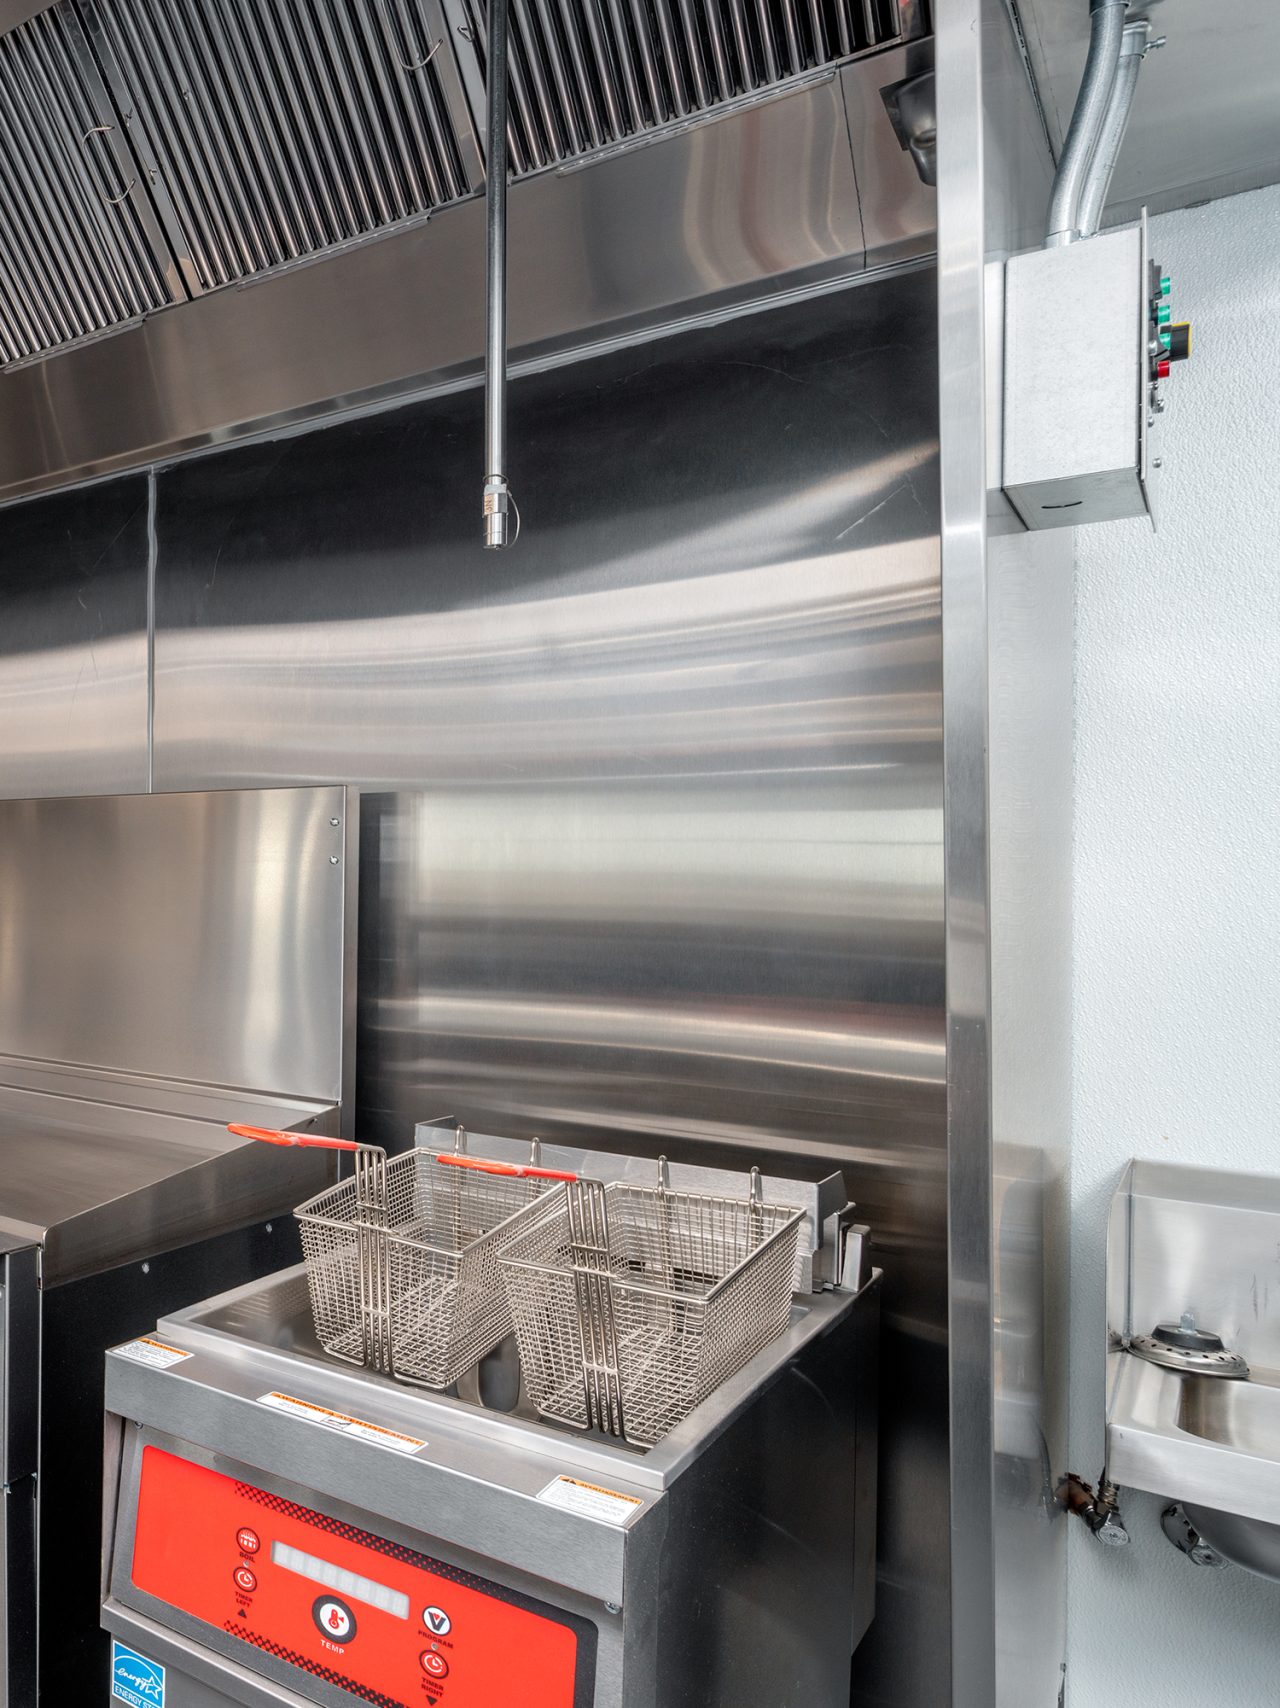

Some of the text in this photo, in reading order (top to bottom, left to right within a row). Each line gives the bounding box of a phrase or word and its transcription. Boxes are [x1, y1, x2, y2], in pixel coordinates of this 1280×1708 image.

[239, 1551, 255, 1563] BOIL
[234, 1591, 253, 1603] TIMER
[236, 1598, 250, 1608] LEFT
[320, 1639, 345, 1654] TEMP
[418, 1630, 454, 1649] PROGRAM
[421, 1683, 444, 1698] RIGHT
[422, 1677, 444, 1692] TIMER
[115, 1685, 142, 1706] ENERGY
